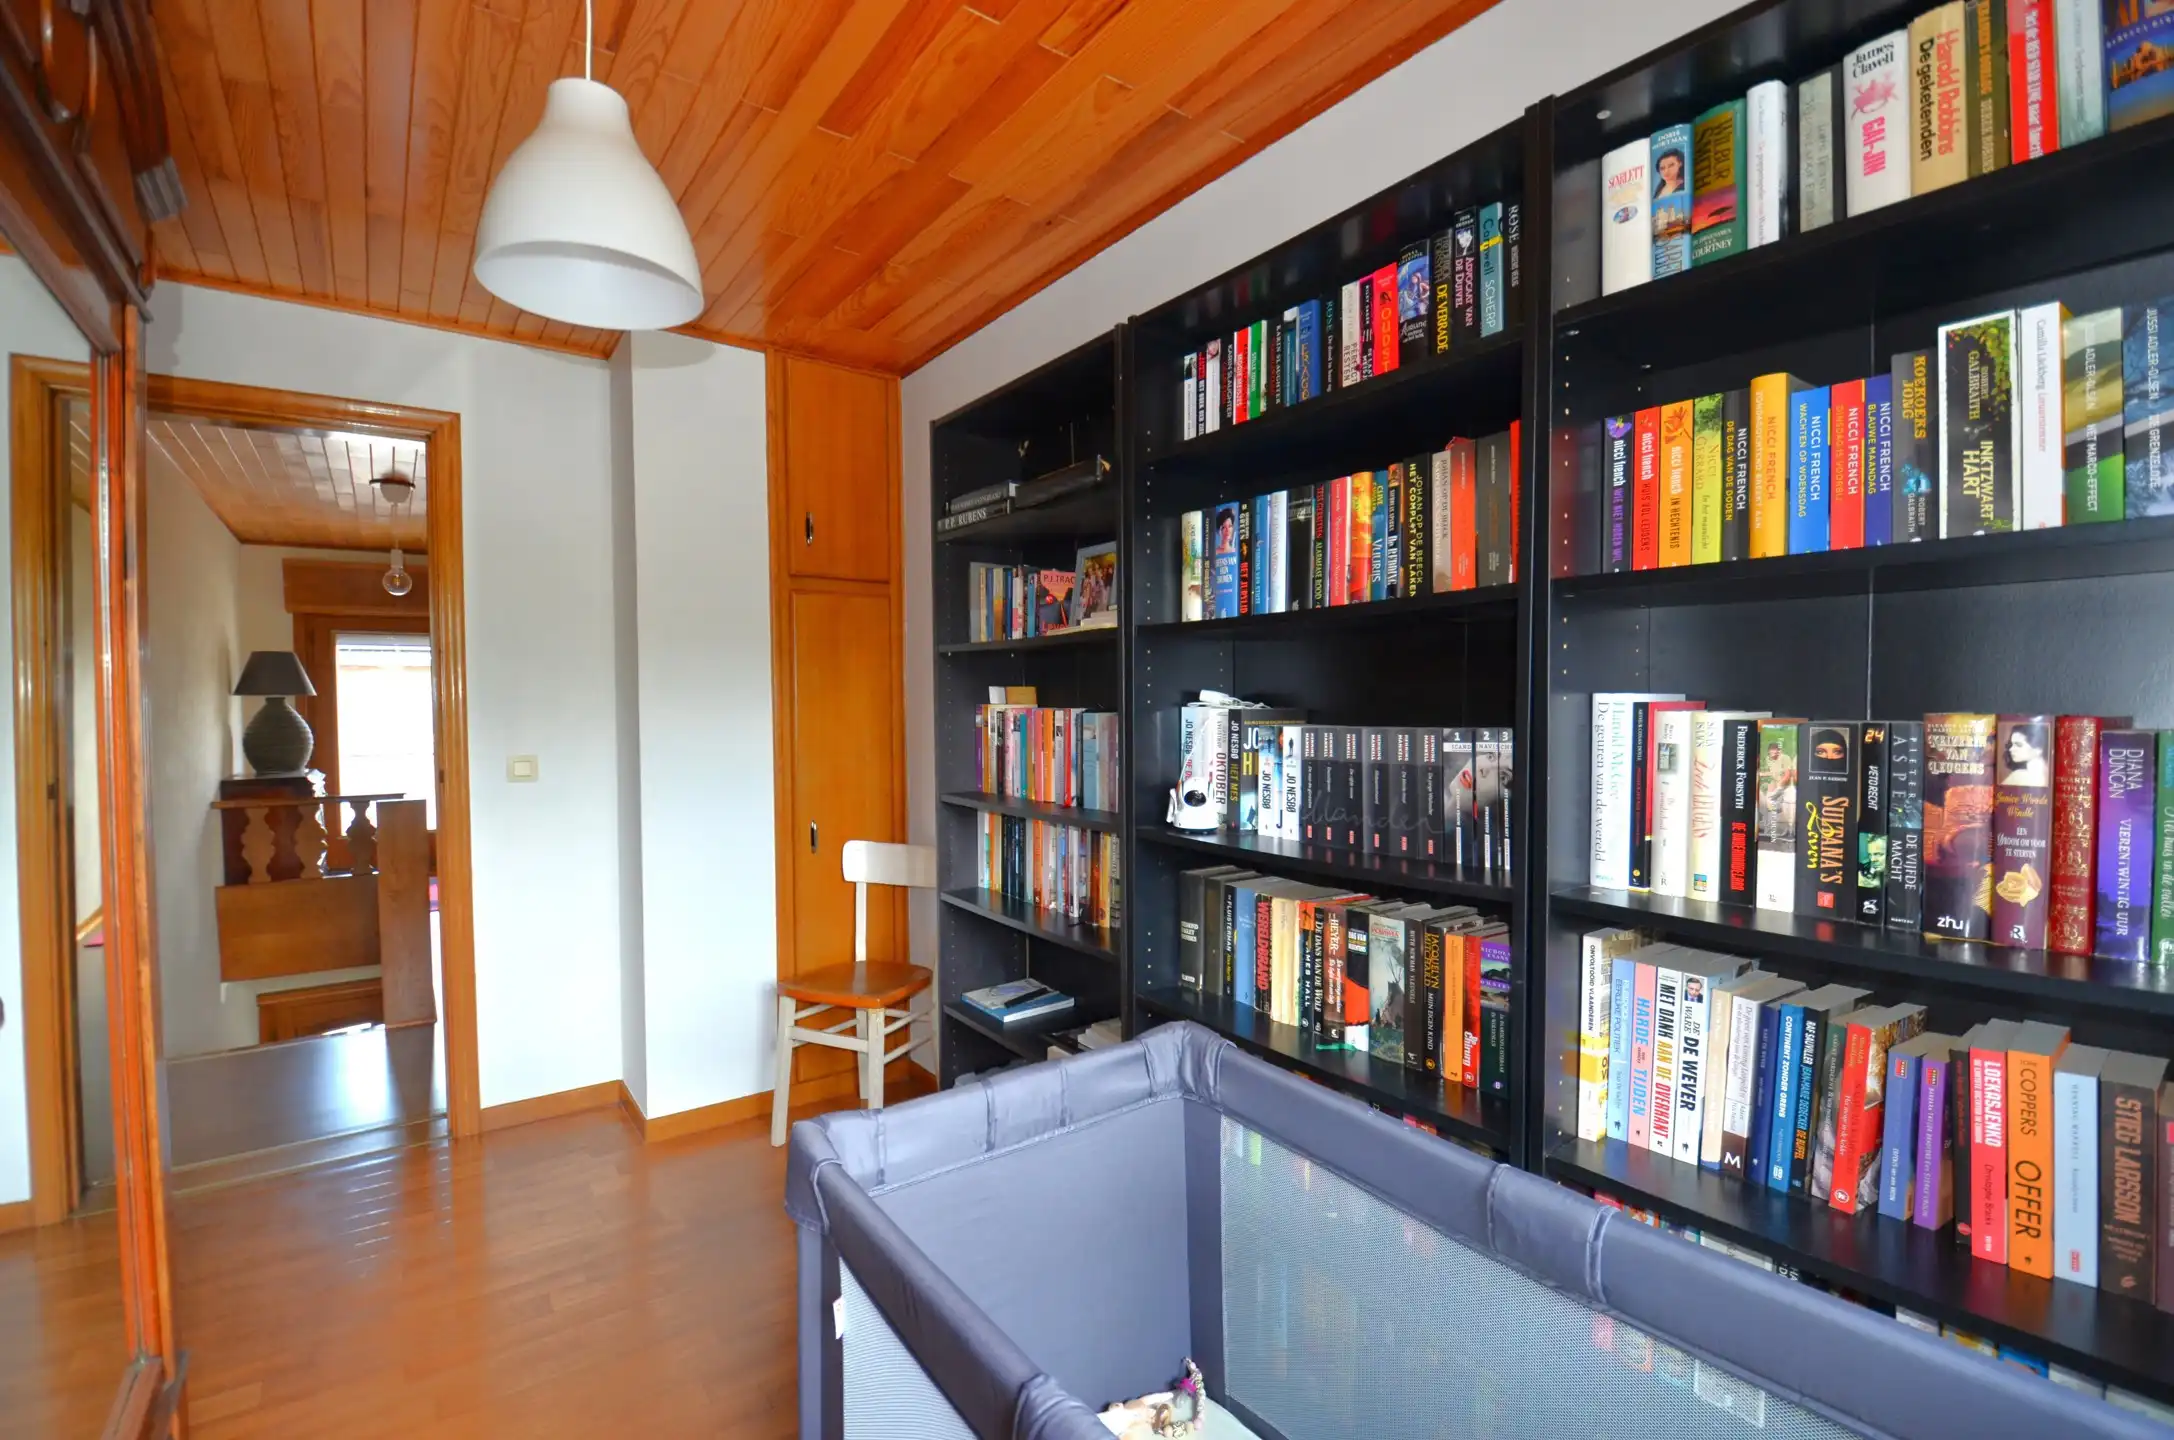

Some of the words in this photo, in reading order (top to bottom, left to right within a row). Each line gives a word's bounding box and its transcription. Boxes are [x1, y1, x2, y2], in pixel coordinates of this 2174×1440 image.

[1852, 51, 1894, 79] Clavell
[1853, 42, 1894, 66] James
[1919, 38, 1933, 63] De
[1936, 29, 1958, 86] Harold
[1916, 66, 1934, 161] geketenden
[1938, 87, 1960, 156] Robbins
[1861, 115, 1886, 177] GAI-JIN
[1607, 165, 1645, 189] SCARLETT
[1509, 204, 1519, 243] ROSE
[1455, 259, 1464, 272] DE
[1465, 257, 1475, 304] ADVOCAAT
[1437, 284, 1448, 300] DE
[1455, 273, 1464, 308] DUIVEL
[1484, 279, 1496, 328] SCHERP
[1465, 305, 1474, 326] VAN
[1902, 380, 1914, 419] JONG
[1968, 350, 1981, 420] GALBRAITH
[1726, 421, 1735, 433] DE
[1767, 416, 1777, 448] NICCI
[1799, 403, 1807, 447] WACHTEN
[1811, 415, 1821, 448] NICCI
[1848, 407, 1858, 441] NICCI
[1868, 403, 1877, 444] BLAUWE
[1880, 402, 1890, 436] NICCI
[1641, 432, 1653, 454] nicci
[1671, 446, 1682, 467] nicci
[1726, 435, 1734, 453] DAG
[1737, 428, 1748, 460] NICCI
[1799, 450, 1807, 463] OP
[1641, 454, 1654, 480] french
[1726, 456, 1734, 473] VAN
[1766, 452, 1777, 500] FRENCH
[1810, 452, 1821, 501] FRENCH
[1847, 445, 1858, 495] FRENCH
[1868, 446, 1876, 494] MAANDAG
[1880, 440, 1891, 492] FRENCH
[1963, 450, 1980, 498] HART
[1980, 440, 1994, 521] INKTZWART
[2086, 444, 2098, 512] MARCO-EFFECT
[1640, 483, 1651, 499] HUIS
[1671, 468, 1683, 494] french
[1726, 476, 1734, 487] DE
[1736, 463, 1747, 510] FRENCH
[1798, 465, 1806, 517] WOENSDAG
[958, 508, 987, 526] RUBENS
[1640, 503, 1650, 516] VOL
[1671, 497, 1680, 506] IN
[1725, 489, 1733, 521] DODEN
[1416, 514, 1423, 528] OP
[1669, 507, 1681, 549] HECHTENIS
[1416, 532, 1423, 545] DE
[1372, 538, 1382, 583] VUURIJS
[1231, 720, 1239, 731] JO
[1598, 701, 1610, 721] De
[1230, 733, 1239, 759] NESBØ
[1454, 732, 1461, 741] 1
[1483, 731, 1490, 740] 2
[1502, 731, 1509, 740] 3
[1595, 725, 1607, 769] geuren
[1736, 725, 1748, 770] FREDERICK
[1864, 728, 1885, 743] 24
[1216, 752, 1227, 805] OKTOBER
[1230, 763, 1238, 779] HET
[1262, 770, 1271, 785] JO
[1287, 773, 1296, 785] JO
[1596, 773, 1605, 795] van
[2108, 748, 2126, 799] DUNCAN
[2126, 748, 2143, 791] DIANA
[1229, 781, 1238, 802] MES
[1262, 786, 1271, 810] NESBØ
[1285, 786, 1296, 813] NESBØ
[1735, 771, 1747, 810] FORSYTH
[1868, 765, 1879, 811] VETORECHT
[1595, 798, 1608, 814] de
[1594, 818, 1607, 862] wereld
[1805, 801, 1834, 869] Leven
[1820, 796, 1849, 884] SULTANA'S
[1905, 834, 1917, 849] DE
[2016, 826, 2028, 836] EEN
[1890, 839, 1902, 881] MACHT
[1905, 853, 1917, 890] VIJFDE
[1315, 921, 1323, 934] DE
[1330, 918, 1339, 951] HEYER
[1937, 916, 1964, 930] zhu
[2115, 911, 2128, 937] UUR
[1257, 901, 1270, 990] WERELDBRAND
[1315, 935, 1323, 956] DANS
[1431, 933, 1440, 989] JACQUELYN
[1314, 958, 1322, 975] VAN
[1315, 976, 1322, 987] DE
[1314, 988, 1323, 1012] WOLF
[1659, 983, 1676, 1006] MET
[1635, 997, 1651, 1046] HARDE
[1657, 1008, 1675, 1040] DANK
[1684, 1006, 1693, 1033] WARE
[1693, 1021, 1700, 1035] DE
[1807, 1020, 1816, 1033] RAF
[1463, 1031, 1473, 1067] Chirurg
[1656, 1041, 1673, 1064] AAN
[1683, 1037, 1700, 1057] DE
[1783, 1015, 1793, 1059] CONTINENT
[1804, 1033, 1815, 1065] SAUVILLER
[1656, 1065, 1672, 1081] DE
[1680, 1060, 1699, 1112] WEVER
[1780, 1060, 1790, 1092] ZONDER
[1800, 1065, 1812, 1100] JEAN-MARIE
[1632, 1068, 1648, 1117] TIJDEN
[1778, 1092, 1787, 1118] GRENS
[1983, 1060, 2002, 1148] LOEKASJENKO
[2020, 1067, 2037, 1137] COPPERS
[1797, 1099, 1810, 1130] DEDECKER
[2114, 1096, 2142, 1145] STIEG
[1795, 1138, 1805, 1160] BUFFEL
[1796, 1129, 1806, 1138] DE
[2014, 1159, 2042, 1240] OFFER
[2114, 1147, 2142, 1225] LARSSON
